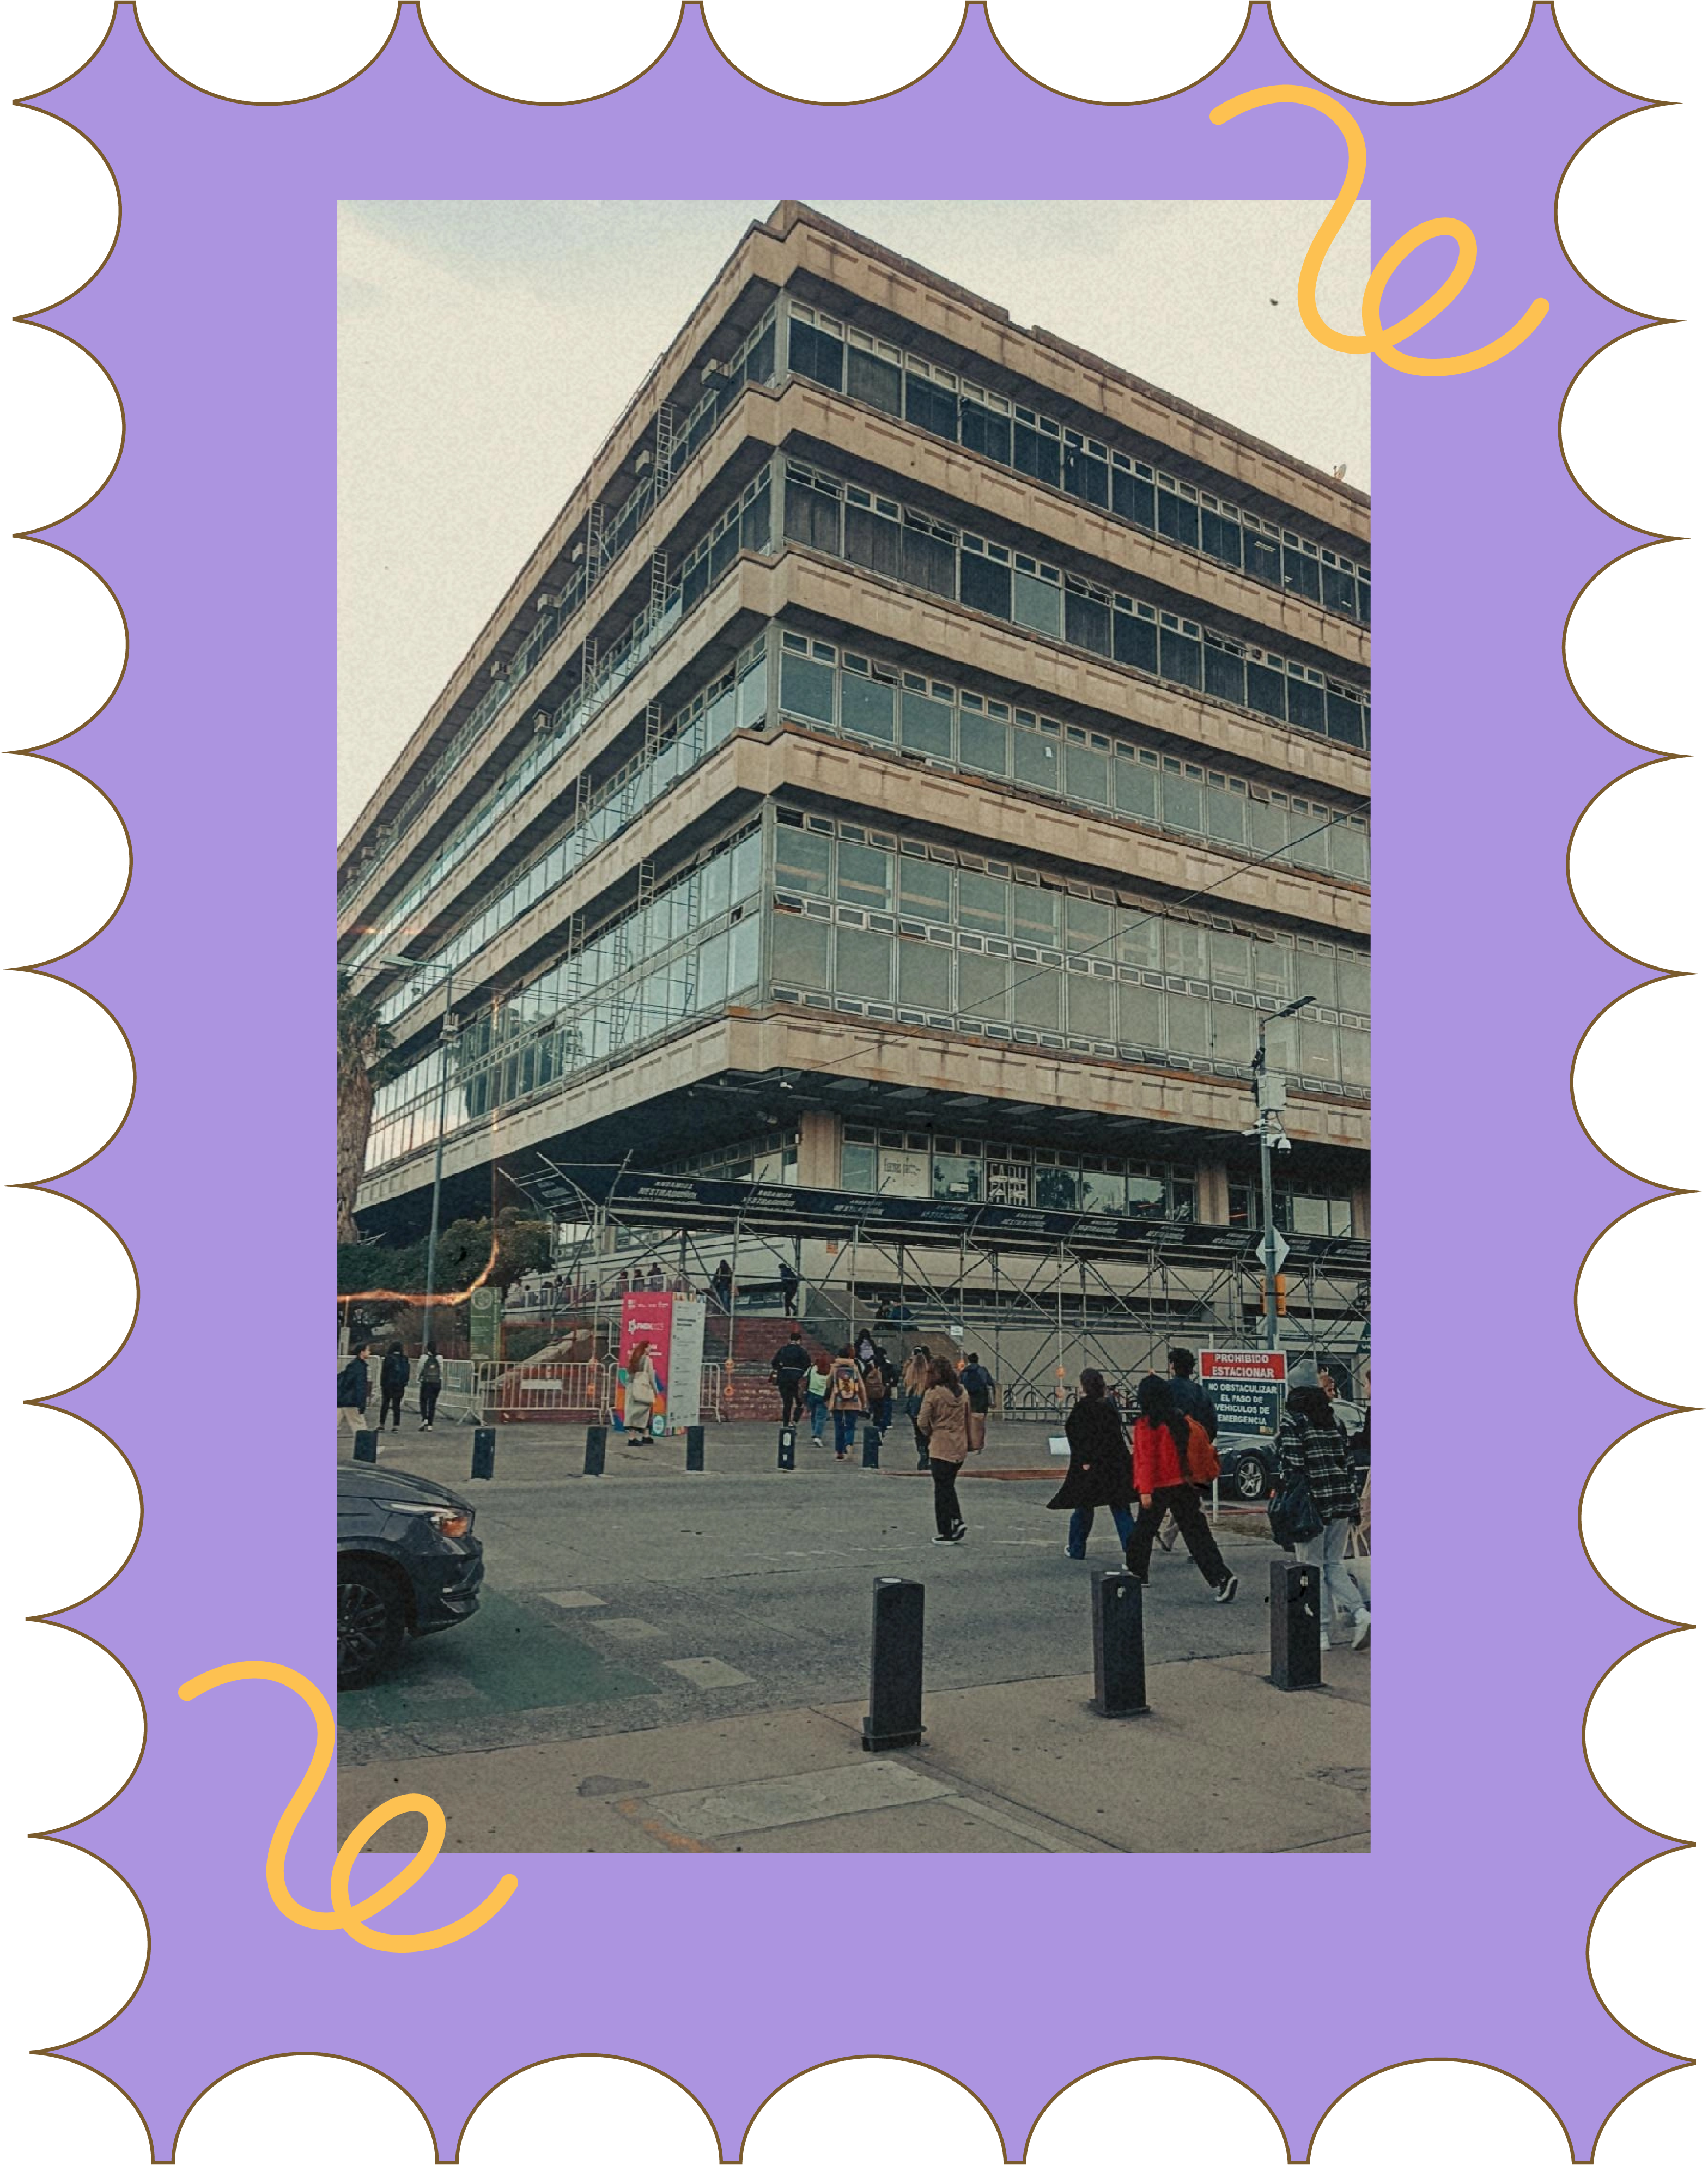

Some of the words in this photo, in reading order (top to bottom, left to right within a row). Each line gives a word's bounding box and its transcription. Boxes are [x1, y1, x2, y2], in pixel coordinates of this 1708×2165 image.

[1215, 1353, 1269, 1363] PROHIBIDO
[1212, 1366, 1274, 1377] ESTACIONAR
[1207, 1383, 1219, 1391] NO
[1220, 1384, 1277, 1394] OBSTACULIZAR
[1220, 1394, 1230, 1402] EL
[1231, 1394, 1251, 1403] PASO
[1253, 1396, 1264, 1404] DE
[1214, 1403, 1257, 1414] VEHICULOS
[1259, 1406, 1271, 1415] DE
[1217, 1414, 1267, 1425] EMERGENCIA
